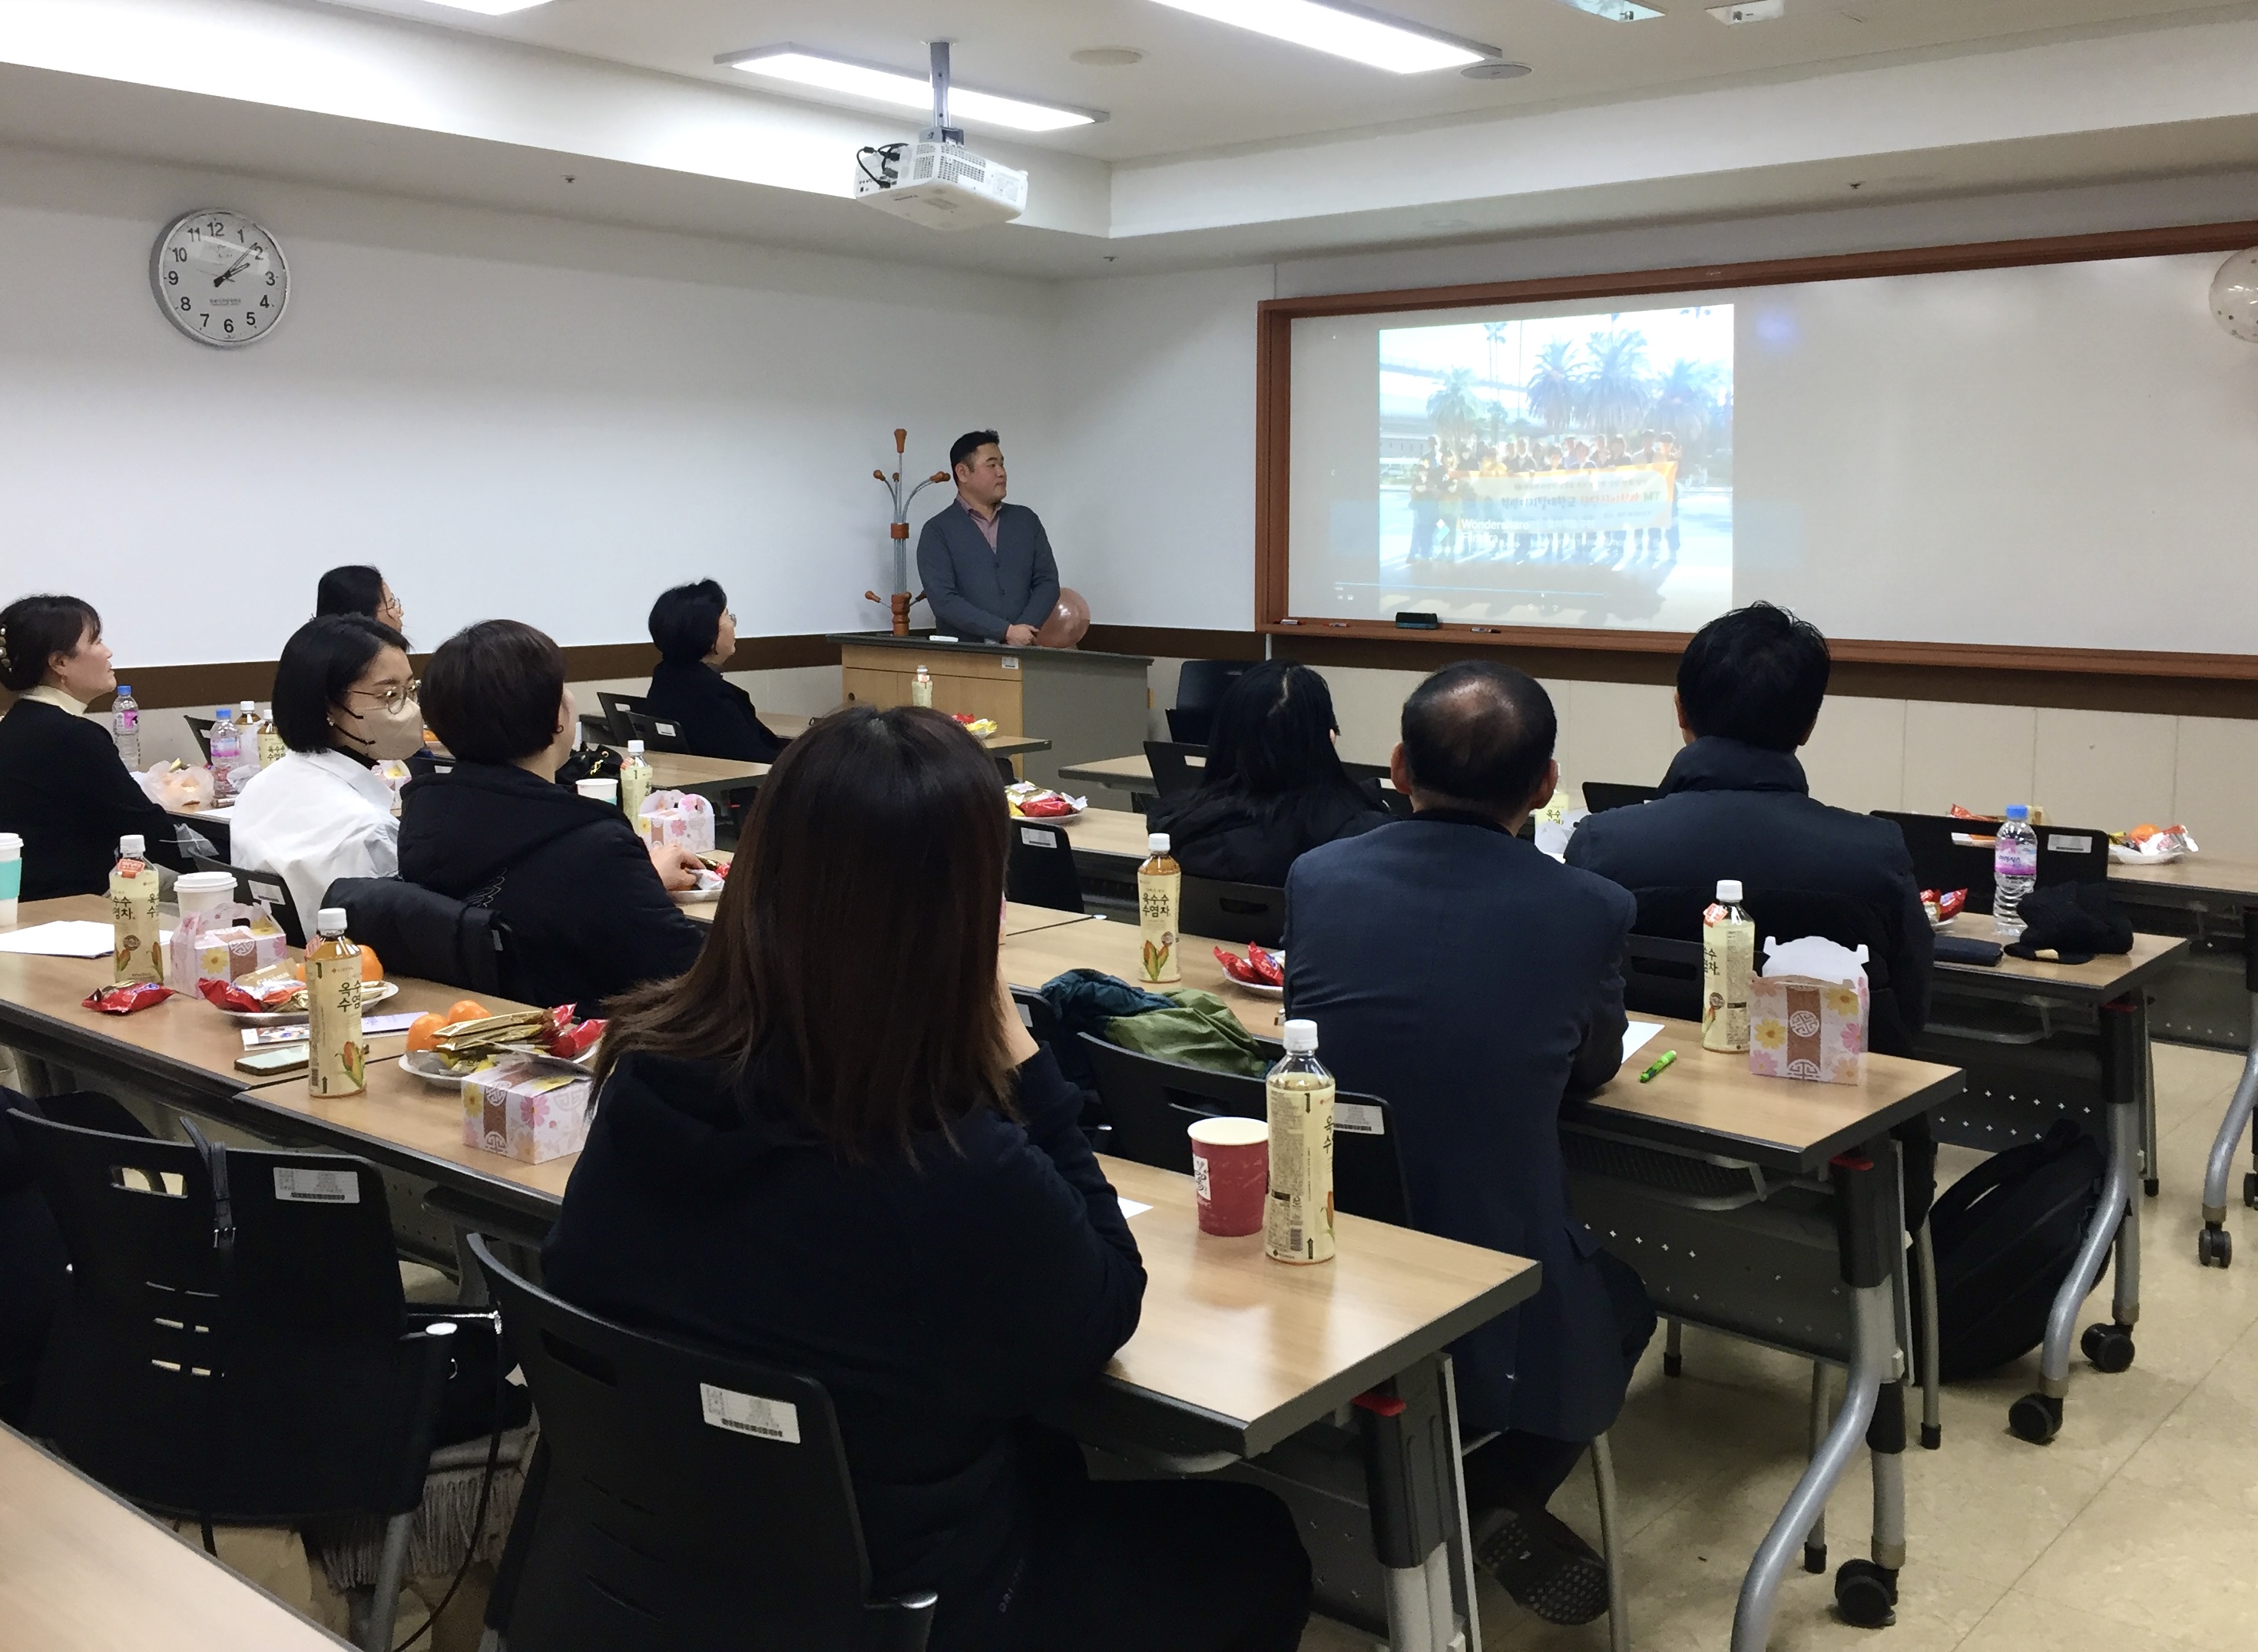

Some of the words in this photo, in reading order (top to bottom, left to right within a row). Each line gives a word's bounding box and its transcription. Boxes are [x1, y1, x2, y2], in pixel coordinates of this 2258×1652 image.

[187, 227, 200, 242] 11
[207, 222, 225, 237] 12
[237, 228, 245, 243] 1
[172, 247, 187, 262] 10
[254, 245, 263, 260] 2
[168, 271, 178, 285] 9
[265, 271, 276, 286] 3
[180, 296, 191, 311] 8
[260, 295, 270, 308] 4
[200, 313, 210, 327] 7
[223, 319, 233, 333] 6
[247, 312, 256, 326] 5
[1644, 491, 1660, 502] MT
[1461, 518, 1529, 530] Wondershare
[1143, 892, 1169, 905] 옥수수
[1143, 905, 1170, 918] 수염차
